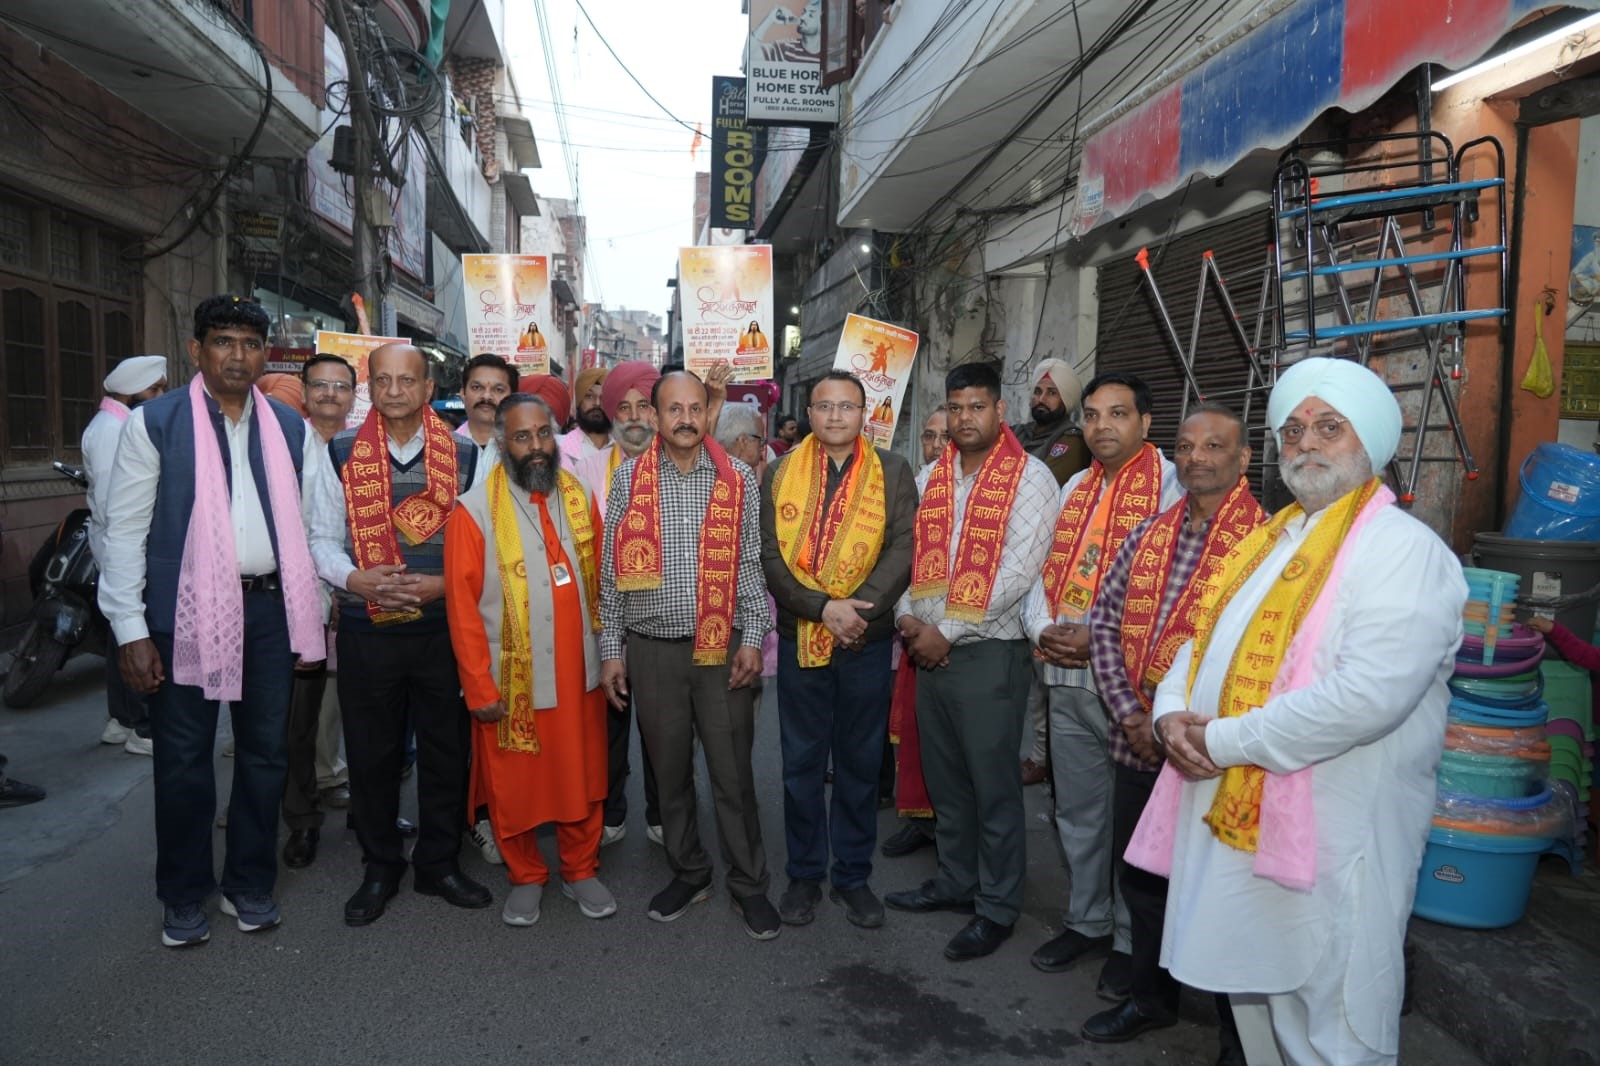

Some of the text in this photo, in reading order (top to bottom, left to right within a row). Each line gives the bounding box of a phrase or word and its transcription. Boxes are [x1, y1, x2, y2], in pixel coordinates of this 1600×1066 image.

[752, 67, 820, 81] BLUE HOR
[756, 82, 832, 96] HOME STAY
[753, 96, 835, 107] FULLY A.C. ROOMS
[716, 117, 745, 129] FULLY
[724, 131, 754, 222] ROOMS
[352, 462, 380, 479] दिव्य
[354, 481, 382, 499] ज्योति
[981, 487, 1007, 503] ज्योति
[356, 501, 385, 518] जाग्रति
[711, 503, 733, 521] दिव्य
[921, 505, 947, 521] संस्थान
[973, 505, 1002, 521] जाग्रति
[358, 522, 387, 541] संस्थान
[707, 526, 732, 542] ज्योति
[970, 527, 997, 544] संस्थान
[707, 547, 731, 562] जाग्रति
[704, 567, 730, 583] संस्थान
[1127, 596, 1154, 614] जाग्रति
